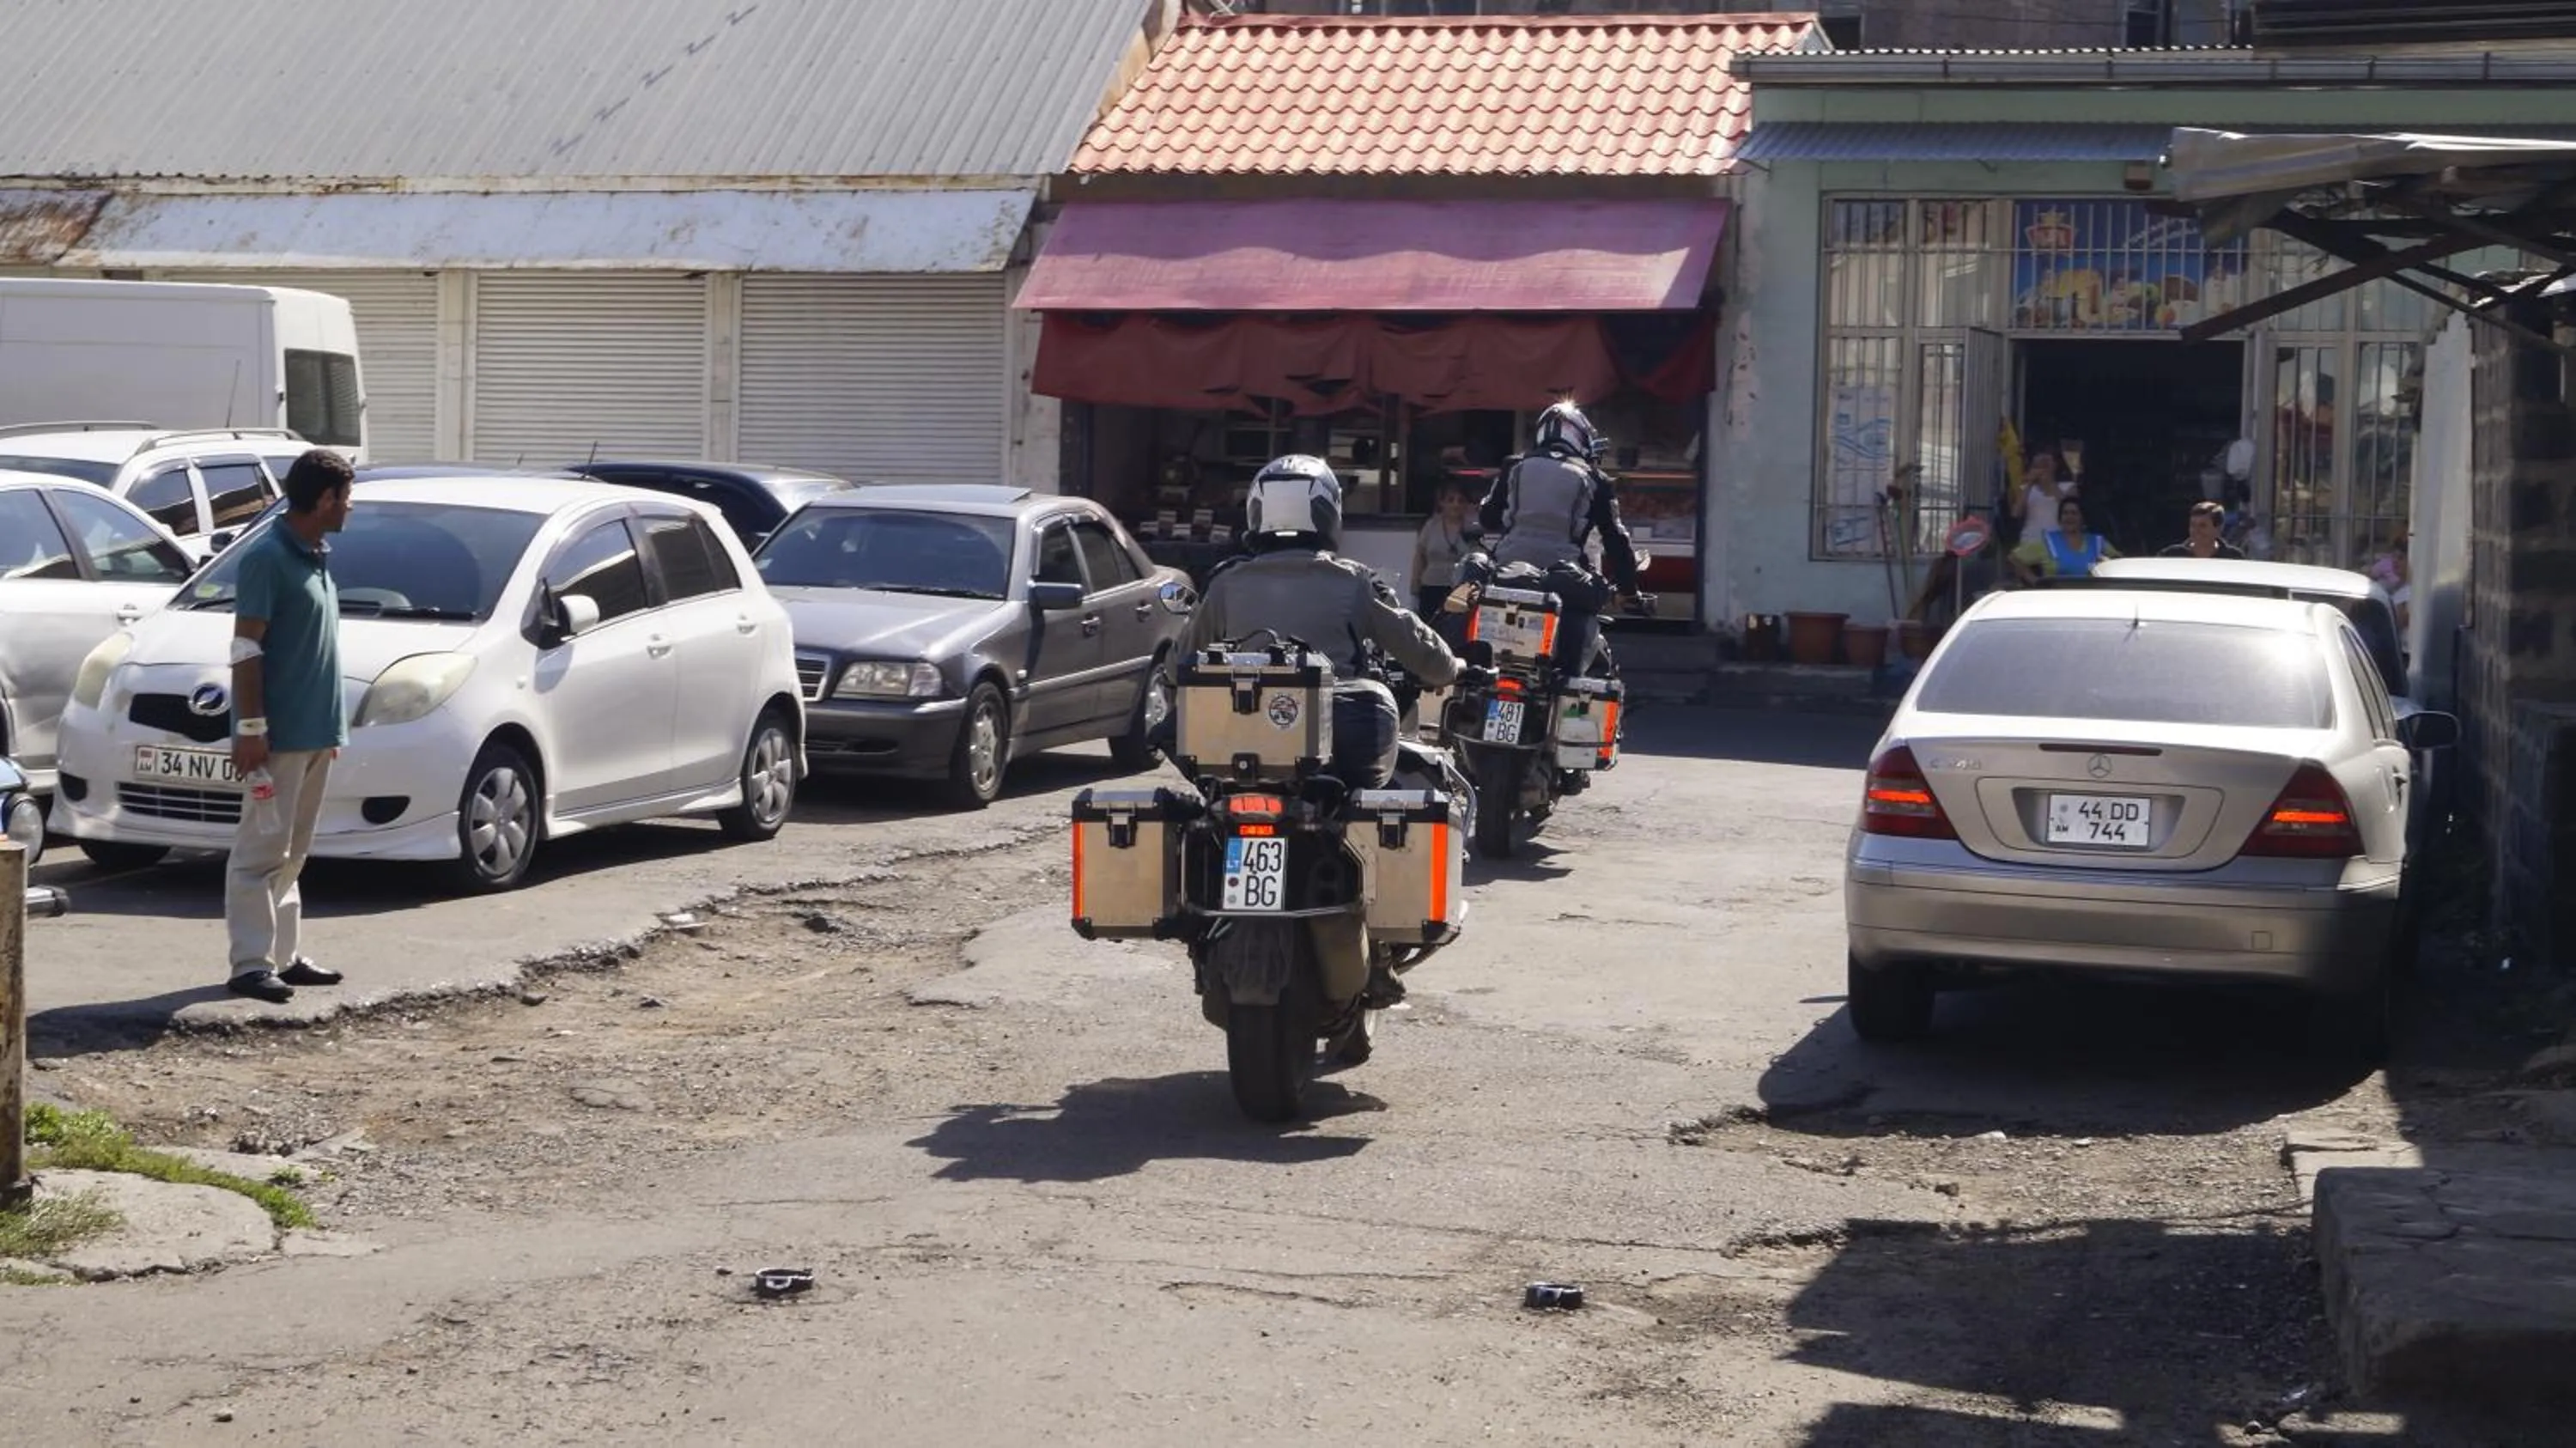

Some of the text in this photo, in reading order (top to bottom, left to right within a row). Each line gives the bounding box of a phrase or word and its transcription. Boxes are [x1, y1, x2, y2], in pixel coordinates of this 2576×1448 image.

[1498, 703, 1522, 722] 481
[1497, 721, 1517, 742] BG
[161, 751, 183, 776] 34
[189, 755, 216, 779] NV
[2079, 801, 2139, 820] 44 DD
[2088, 822, 2125, 840] 744
[1243, 841, 1282, 873] 463
[1244, 874, 1277, 907] BG
